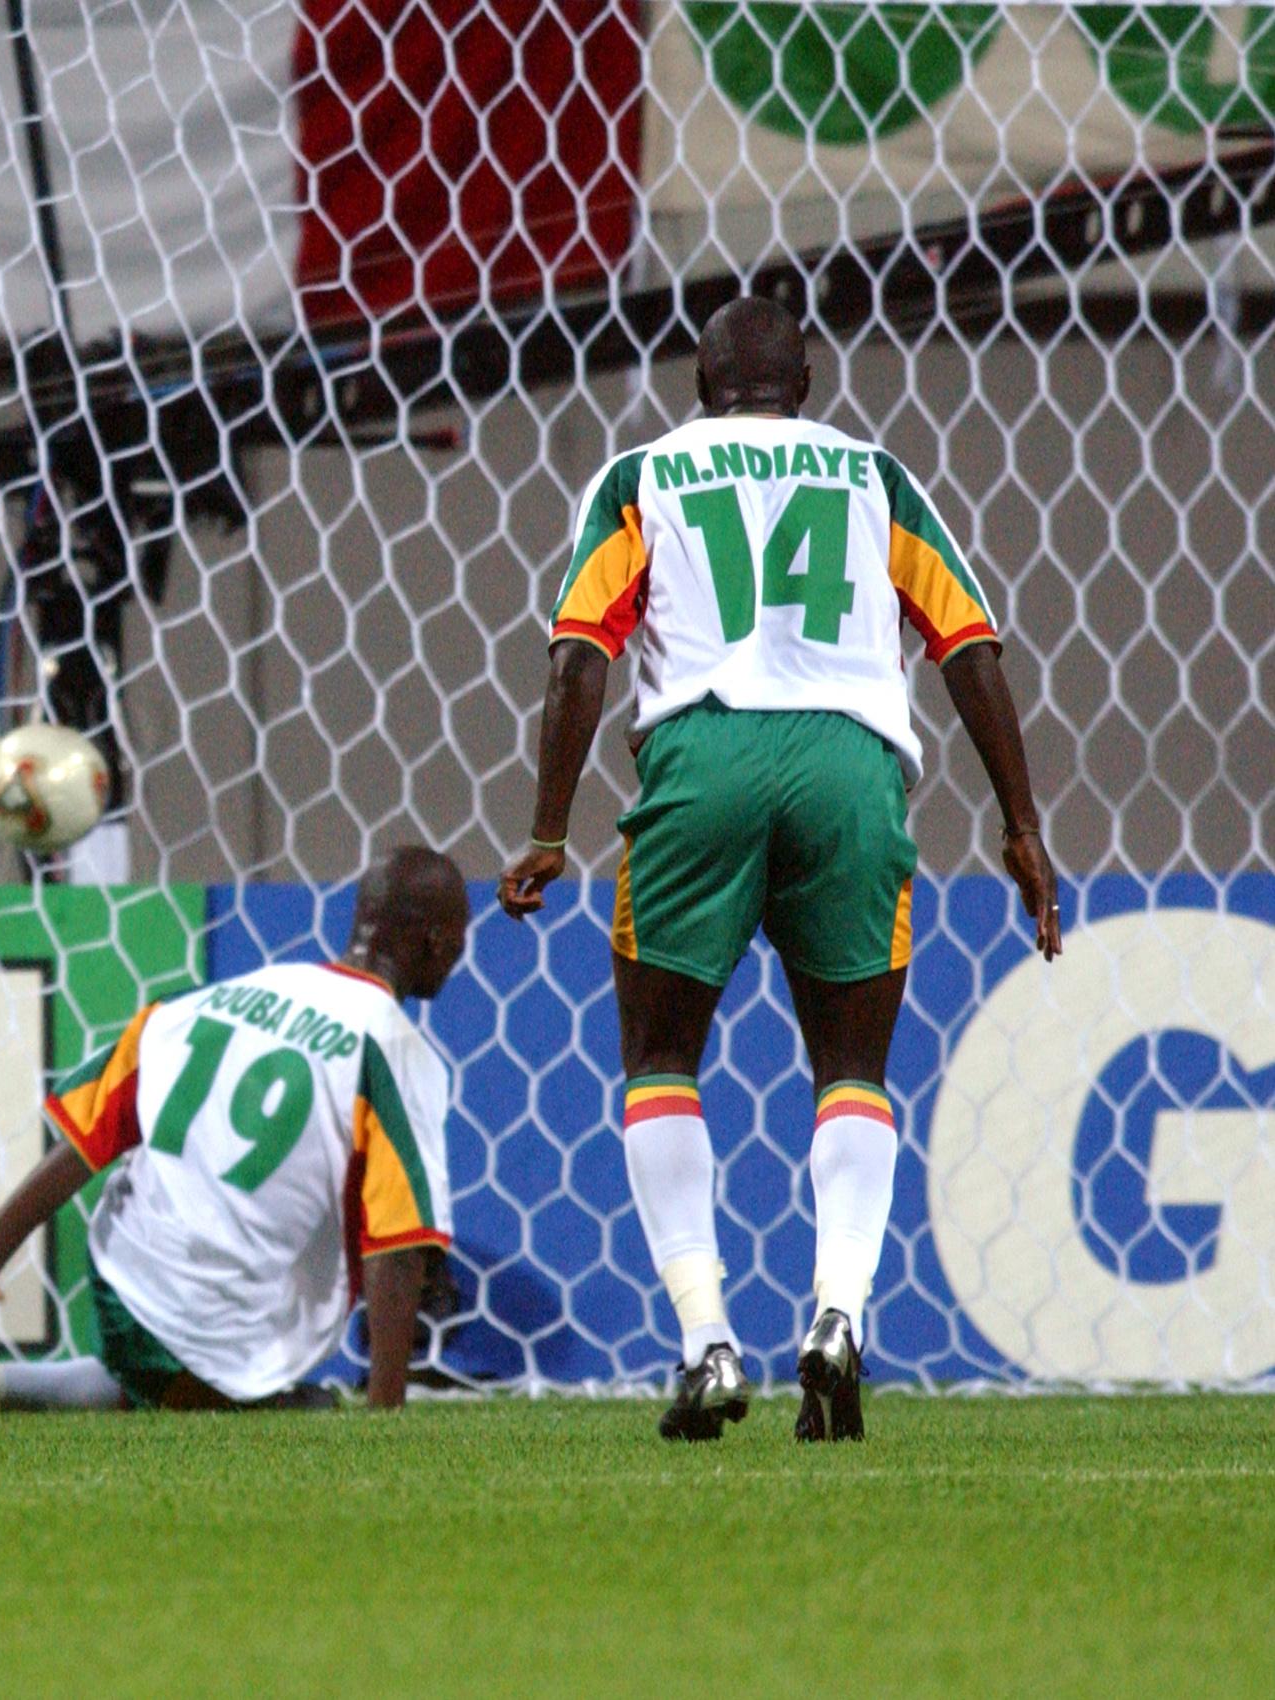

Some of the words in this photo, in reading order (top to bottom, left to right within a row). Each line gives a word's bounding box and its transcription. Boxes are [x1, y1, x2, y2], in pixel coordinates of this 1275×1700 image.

[652, 442, 870, 490] M.NDIAYE
[679, 484, 855, 645] 14
[149, 1015, 315, 1194] 19
[283, 1006, 360, 1061] DIOP
[929, 908, 1275, 1378] G
